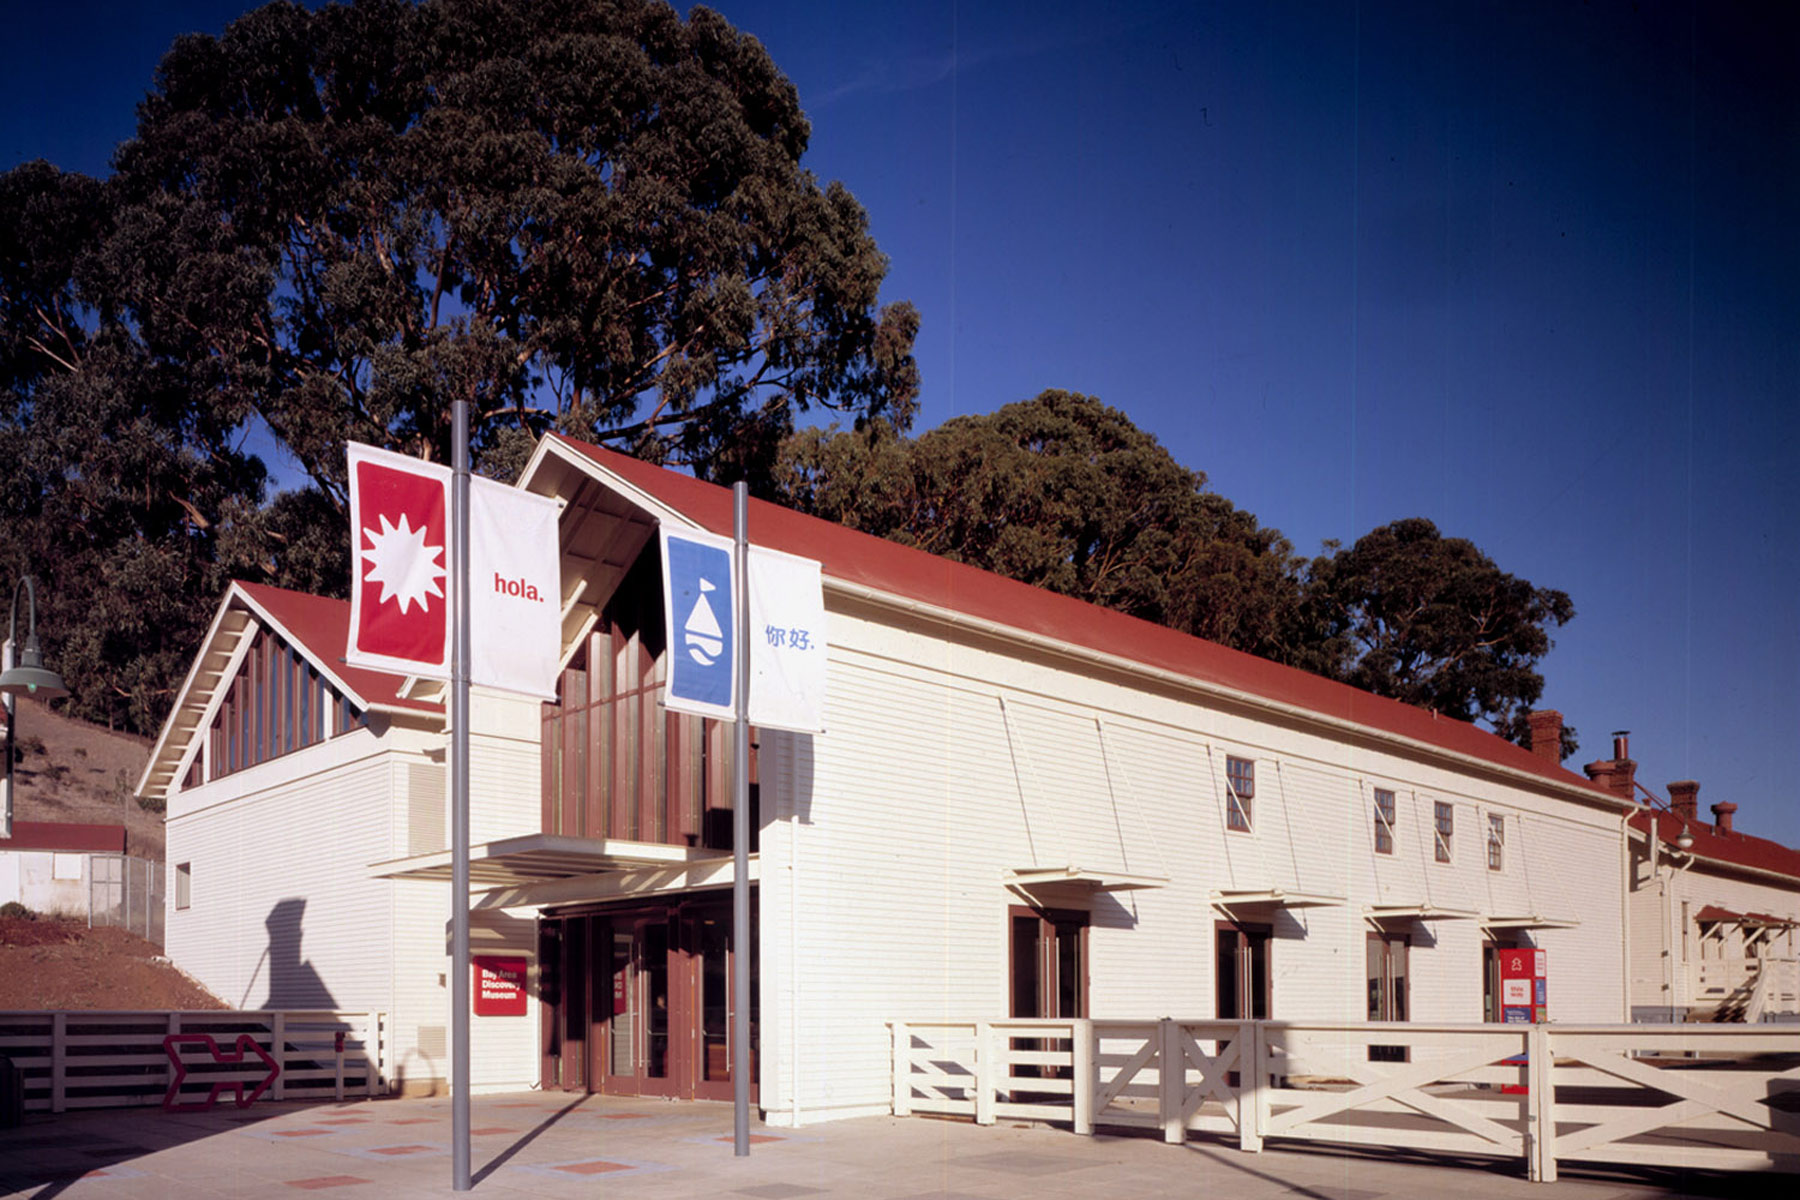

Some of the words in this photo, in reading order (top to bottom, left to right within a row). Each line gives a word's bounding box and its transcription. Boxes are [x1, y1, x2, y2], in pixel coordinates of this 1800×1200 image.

[495, 572, 544, 602] hola.
[482, 969, 497, 980] Bay
[499, 970, 517, 979] Area
[482, 979, 520, 991] Discovery
[482, 990, 517, 999] Museum
